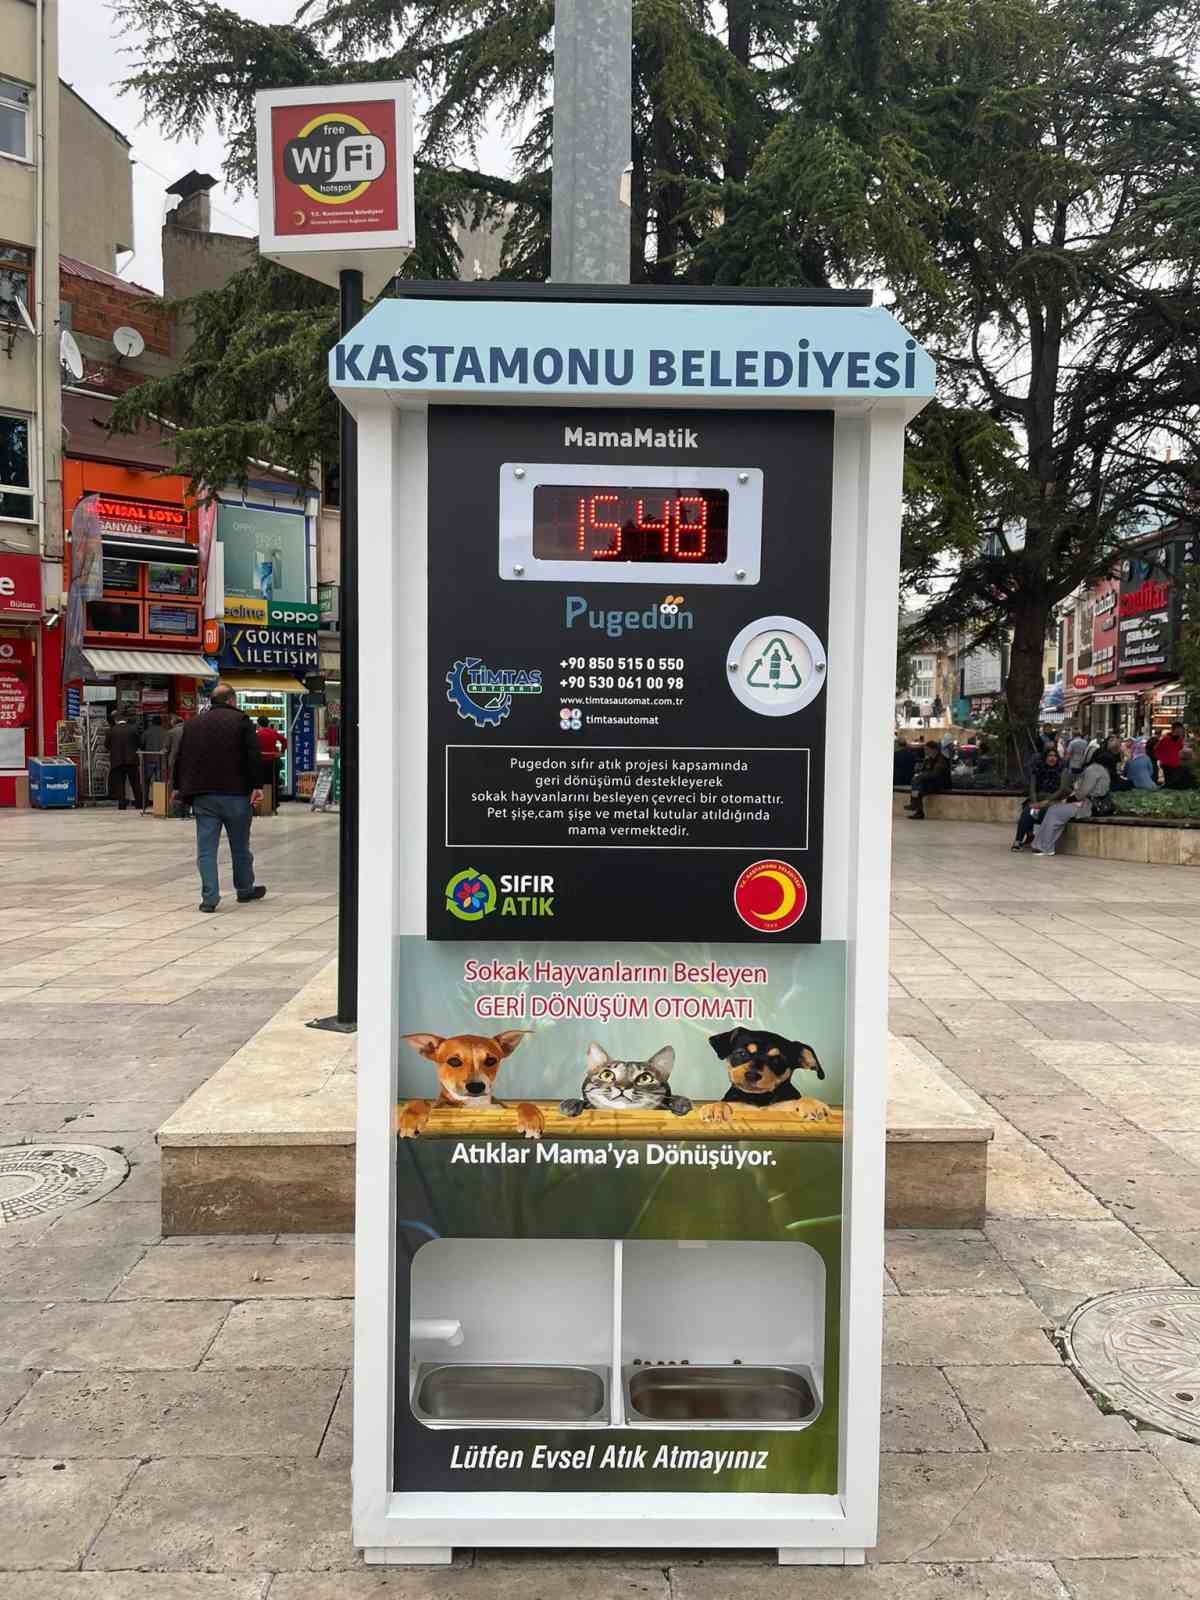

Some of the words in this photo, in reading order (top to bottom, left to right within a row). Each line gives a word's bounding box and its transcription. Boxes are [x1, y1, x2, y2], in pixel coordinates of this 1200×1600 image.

[324, 125, 345, 135] free
[320, 184, 352, 193] hotspot
[335, 344, 634, 386] KASTAMONU
[649, 338, 916, 389] BELEDİYESİ
[564, 426, 699, 448] MamaMatik
[271, 610, 319, 623] oppo
[565, 595, 694, 638] Pugedon
[245, 625, 317, 646] GÖKMEN
[247, 647, 318, 668] İLETİŞİM
[559, 657, 585, 670] +90
[588, 657, 614, 670] 850
[617, 658, 643, 670] 515
[646, 658, 655, 670] 0
[658, 658, 684, 671] 550
[559, 676, 585, 689] +90
[588, 676, 614, 689] 530
[617, 677, 642, 689] 061
[646, 677, 663, 689] 00
[667, 677, 684, 690] 98
[559, 695, 684, 706] www.timtasautomat.com.tr
[586, 714, 660, 725] timtasautomat
[510, 757, 567, 772] Pugedon
[571, 758, 594, 769] sıfır
[598, 758, 622, 770] atık
[625, 759, 668, 773] projesi
[672, 760, 749, 773] kapsamında
[535, 775, 561, 788] geri
[564, 775, 631, 788] dönüşümü
[635, 776, 723, 790] destekleyerek
[471, 790, 508, 802] sokak
[511, 790, 589, 805] hayvanlarını
[593, 791, 649, 805] besleyen
[651, 792, 696, 805] çevreci
[700, 793, 718, 804] bir
[720, 794, 784, 805] otomattır.
[487, 807, 508, 818] Pet
[568, 808, 592, 821] şişe
[596, 810, 610, 819] ve
[614, 808, 649, 819] metal
[653, 809, 698, 820] kutular
[701, 809, 770, 823] atıldığında
[568, 826, 606, 836] mama
[610, 825, 689, 836] vermektedir.
[500, 874, 555, 893] SIFIR
[501, 896, 555, 916] ATIK
[464, 959, 529, 982] Sokak
[534, 961, 669, 987] Hayvanlarını
[674, 962, 768, 988] Besleyen
[476, 992, 525, 1017] GERİ
[531, 993, 649, 1023] DÖNÜŞÜM
[654, 997, 753, 1019] OTOMATI
[450, 1142, 530, 1165] Atıklar
[646, 1143, 777, 1170] Dönüşüyor.
[450, 1444, 524, 1469] Lütfen
[531, 1444, 595, 1469] Evsel
[600, 1444, 646, 1469] Atık
[652, 1444, 769, 1474] Atmayınız
